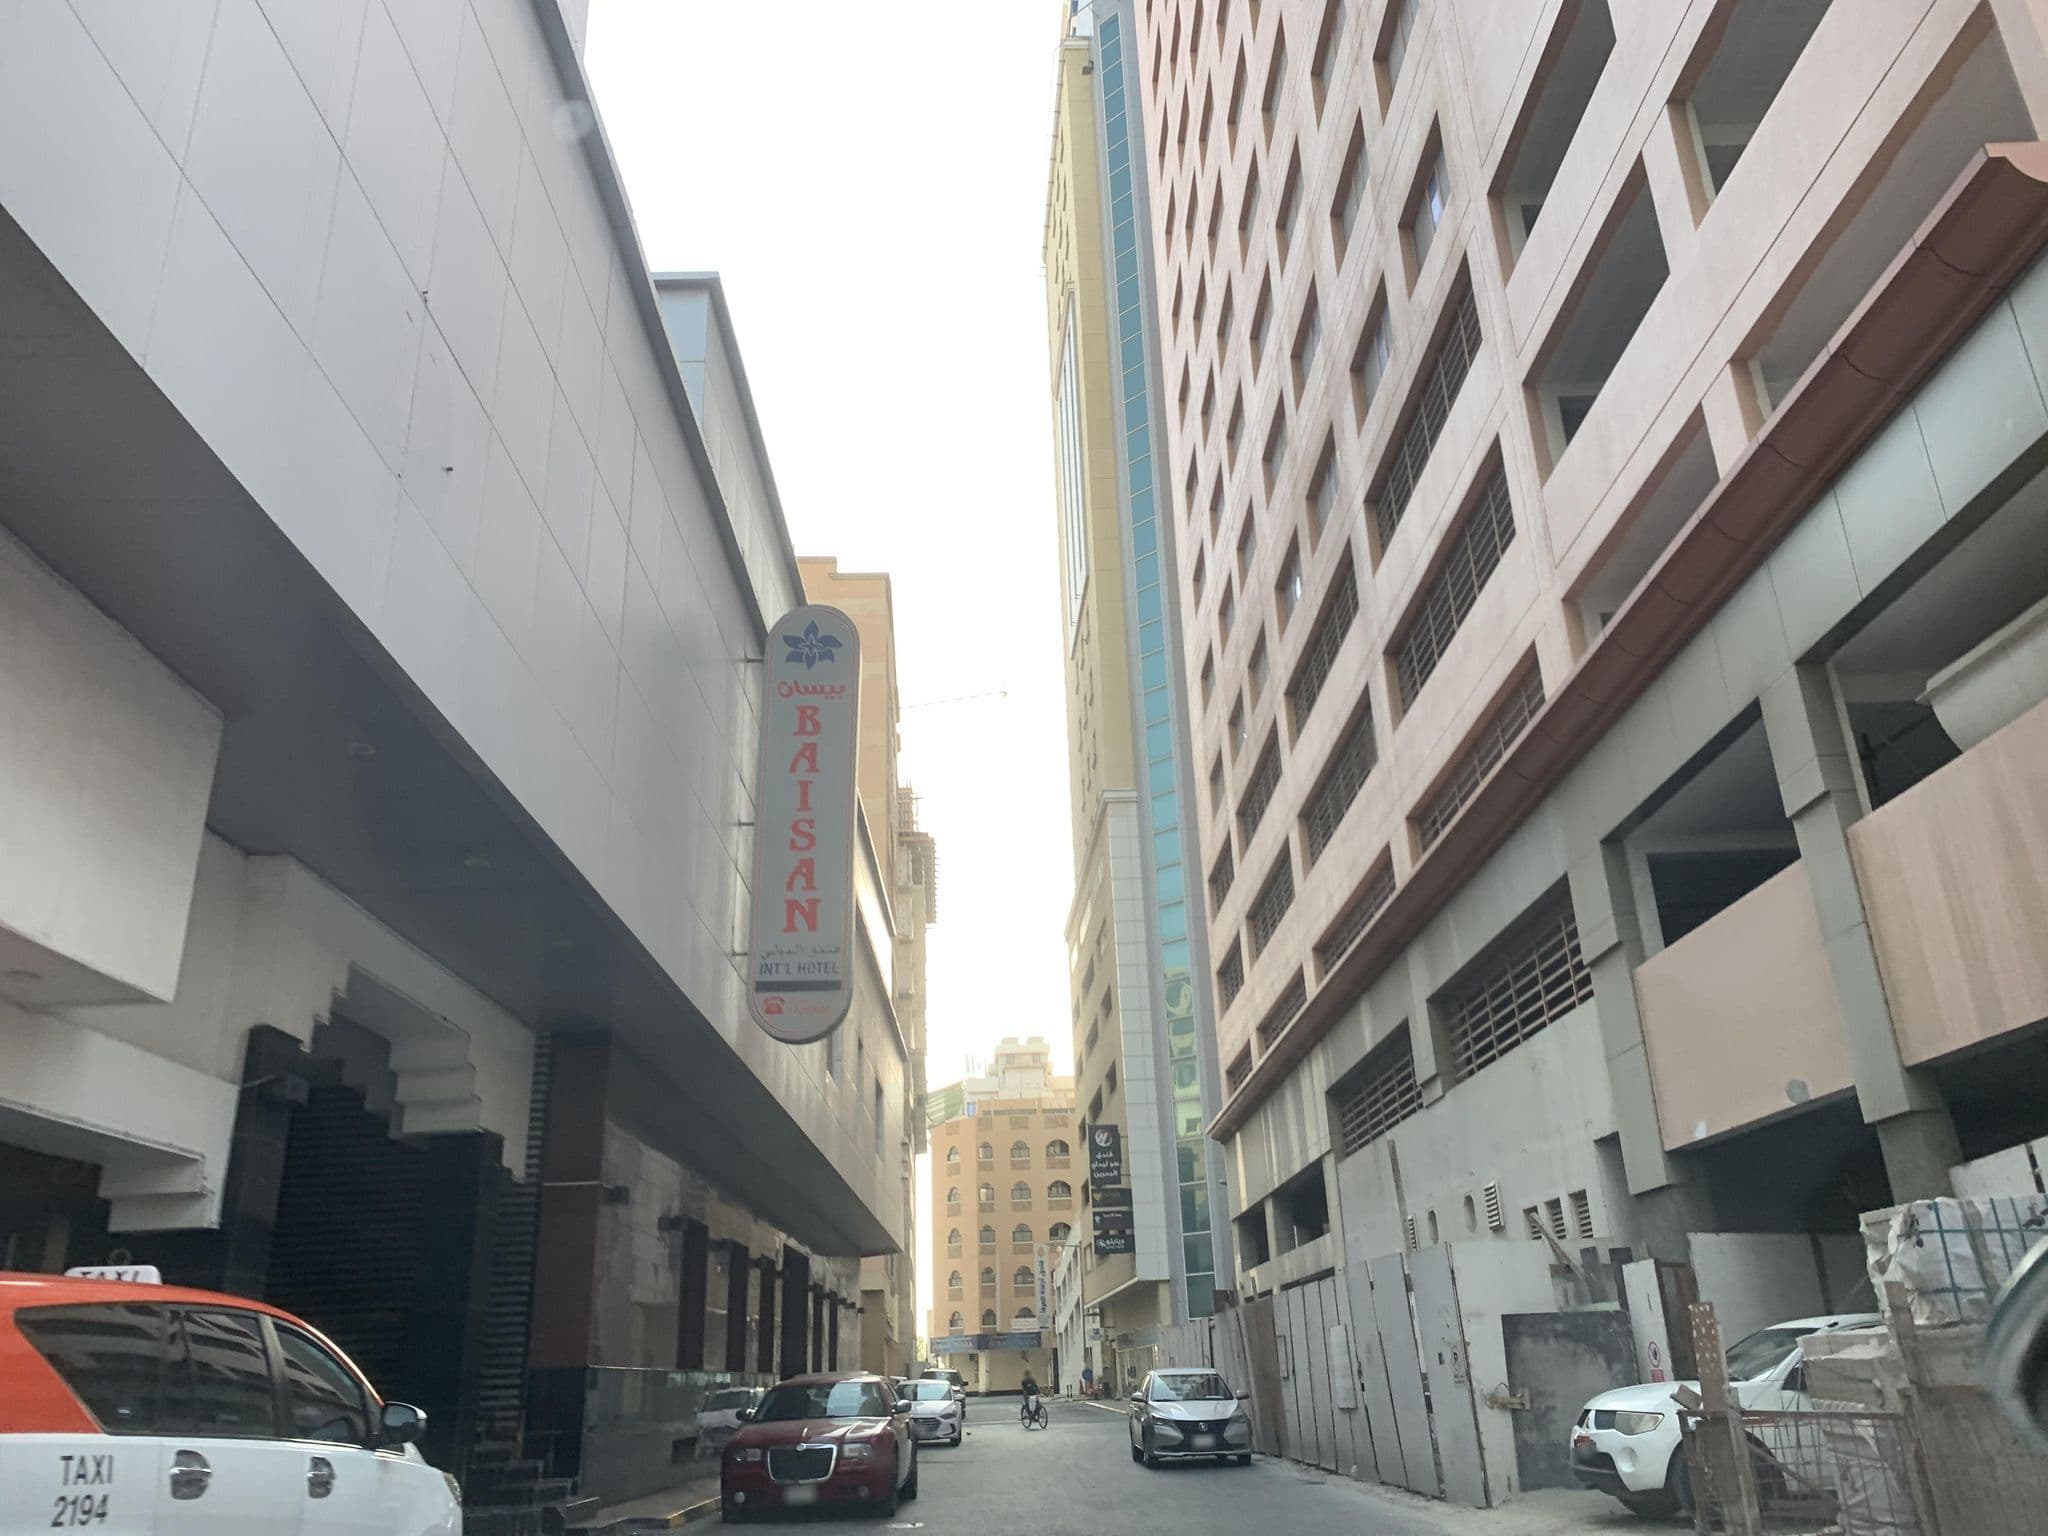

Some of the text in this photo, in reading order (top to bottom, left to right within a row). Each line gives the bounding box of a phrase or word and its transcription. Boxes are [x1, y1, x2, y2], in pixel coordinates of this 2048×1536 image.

[777, 680, 845, 700] بيسان
[782, 705, 822, 934] BAISAN
[798, 960, 840, 975] HOTEL
[1096, 1151, 1113, 1159] فندق
[60, 1454, 114, 1487] TAXI
[51, 1493, 109, 1529] 2194
